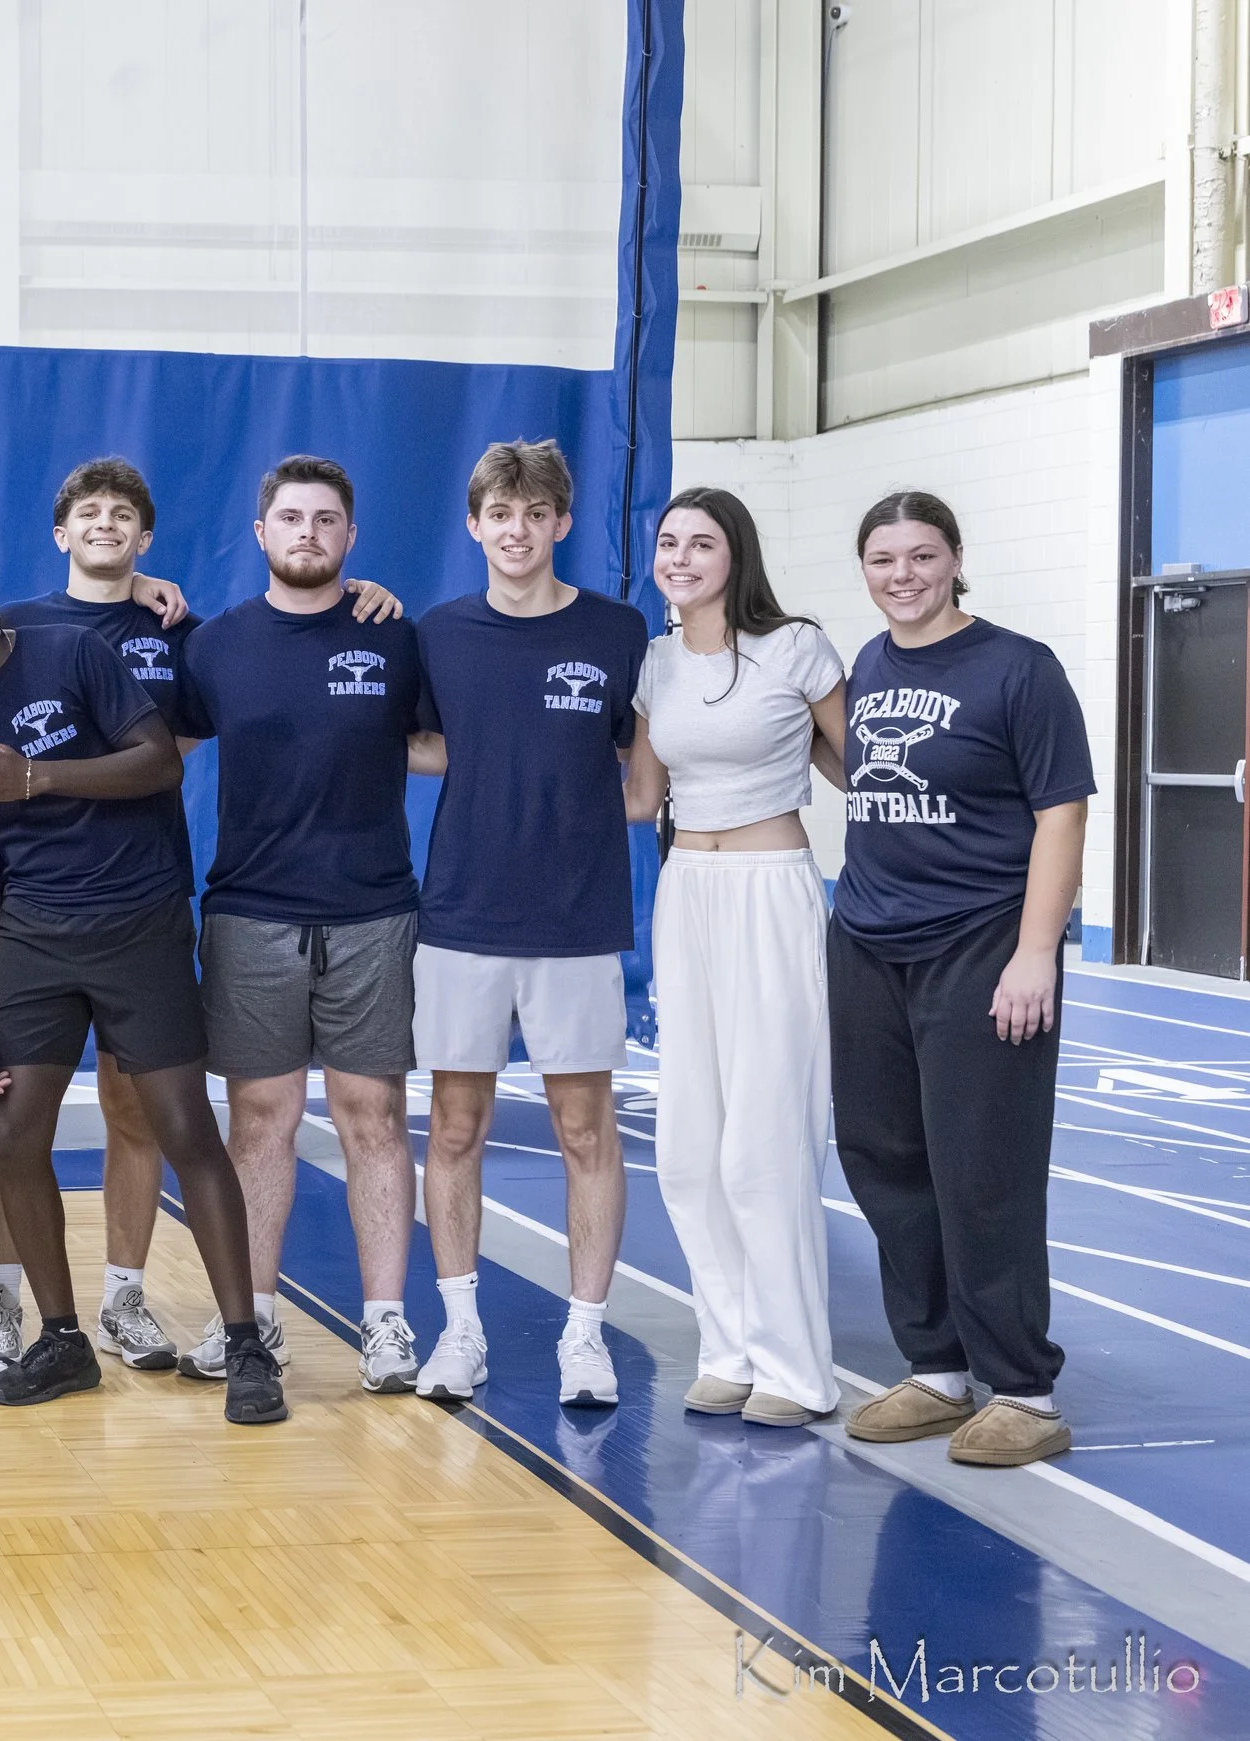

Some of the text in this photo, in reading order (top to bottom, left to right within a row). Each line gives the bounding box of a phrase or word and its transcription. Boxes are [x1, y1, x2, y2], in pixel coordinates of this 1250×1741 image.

[121, 637, 170, 657] PEABODY
[328, 650, 386, 672] PEABODY
[130, 667, 174, 681] ANNERS
[546, 661, 608, 687] PEABODY
[327, 681, 386, 696] TANNERS
[543, 694, 603, 714] TANNERS
[849, 688, 961, 731] PEABODY
[11, 700, 63, 735] PEABODY
[21, 723, 78, 758] TANNERS
[869, 745, 900, 762] 2022
